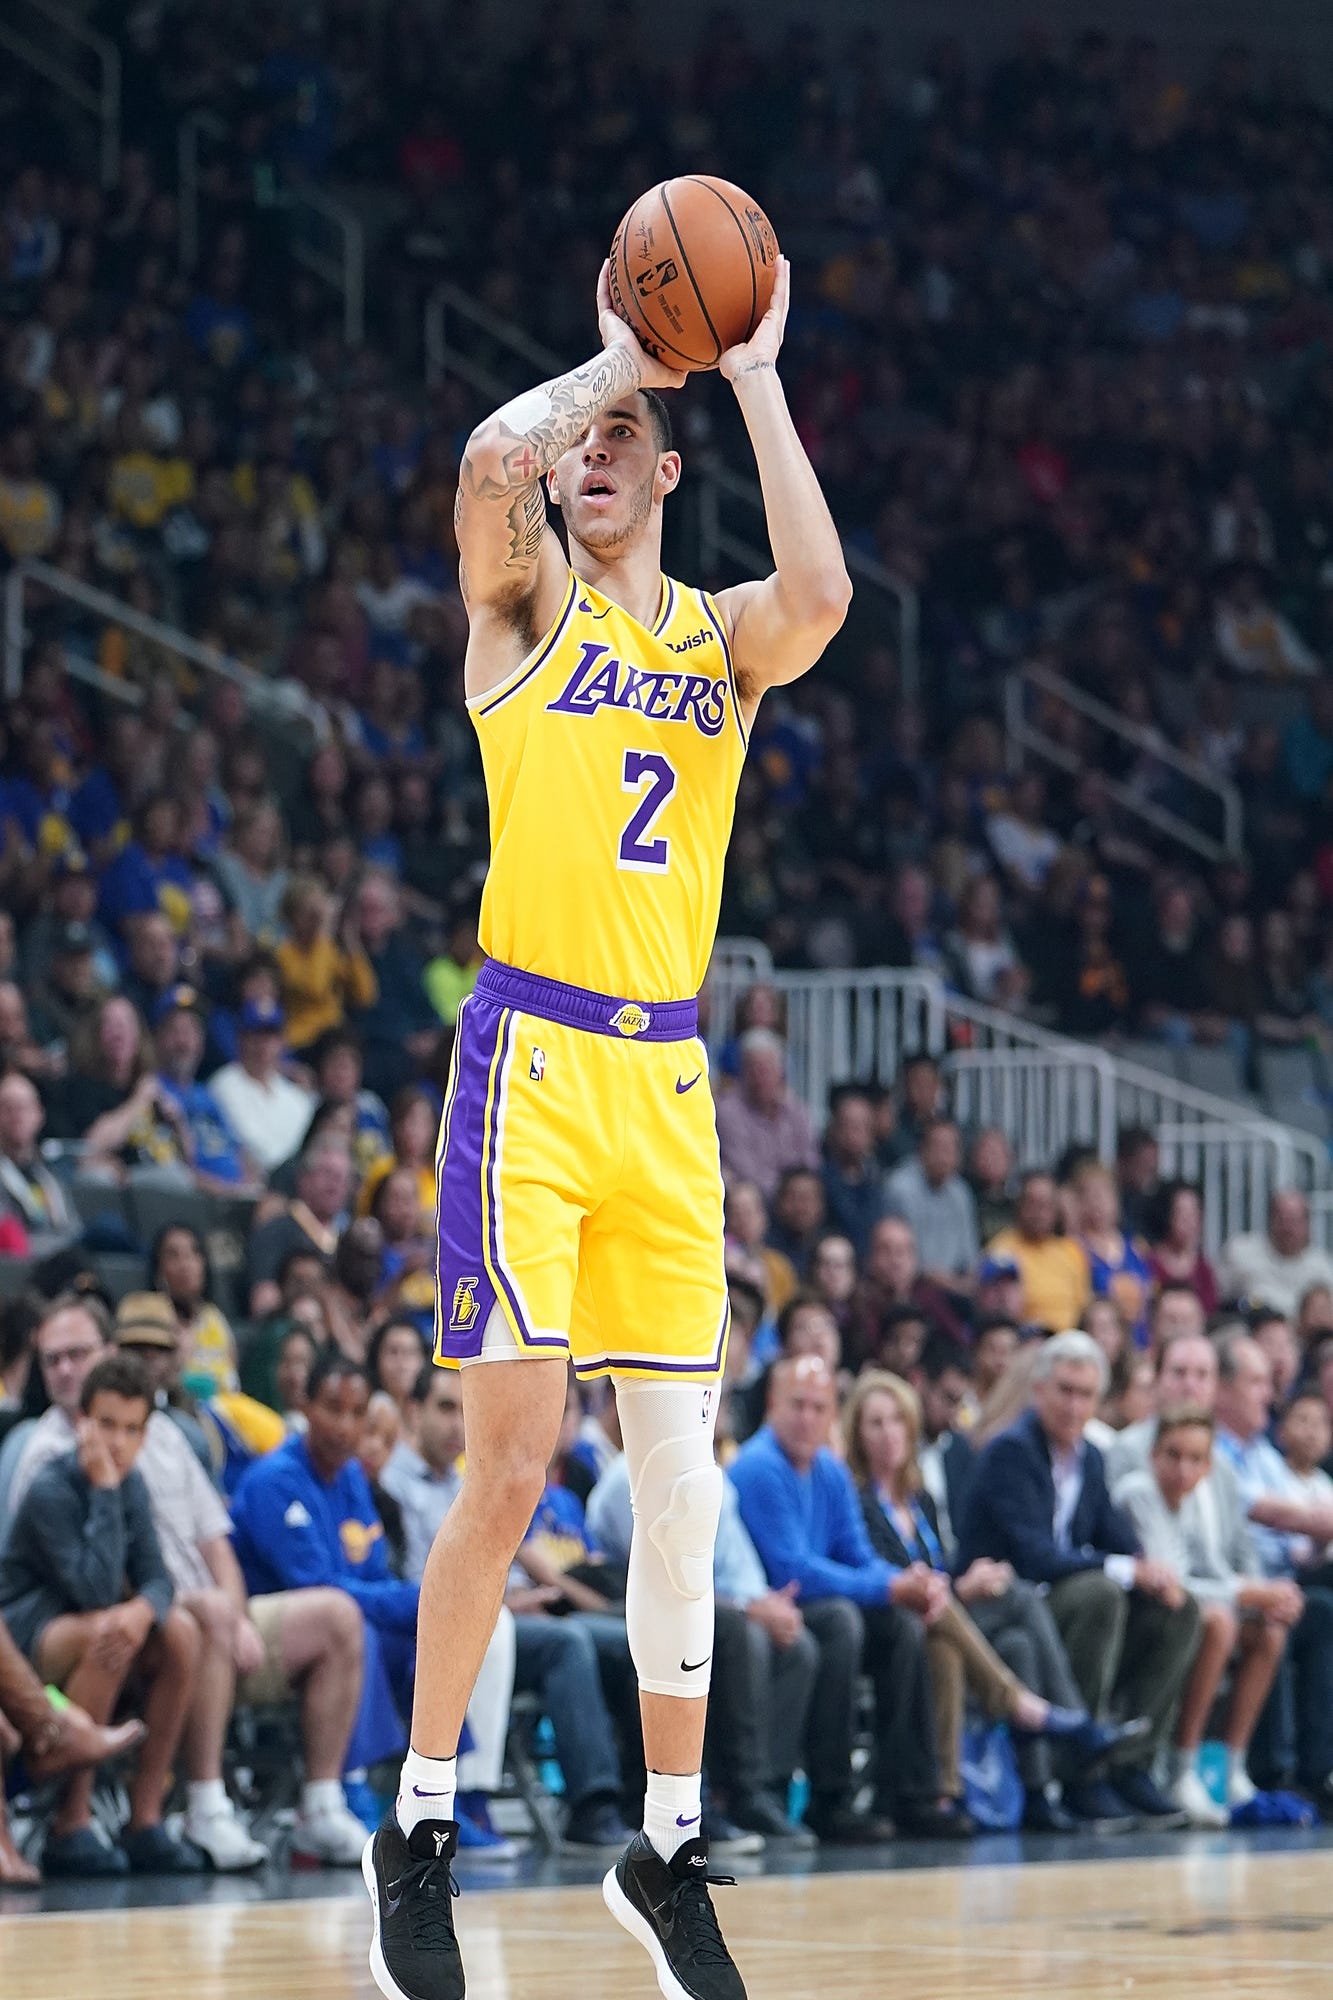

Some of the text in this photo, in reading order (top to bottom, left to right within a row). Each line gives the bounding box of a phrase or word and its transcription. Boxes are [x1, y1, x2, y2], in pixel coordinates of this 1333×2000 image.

[609, 233, 666, 361] SLDING
[545, 641, 728, 737] LAKERS
[665, 628, 714, 654] wish
[618, 749, 676, 871] 2
[612, 1010, 648, 1030] LAKERS
